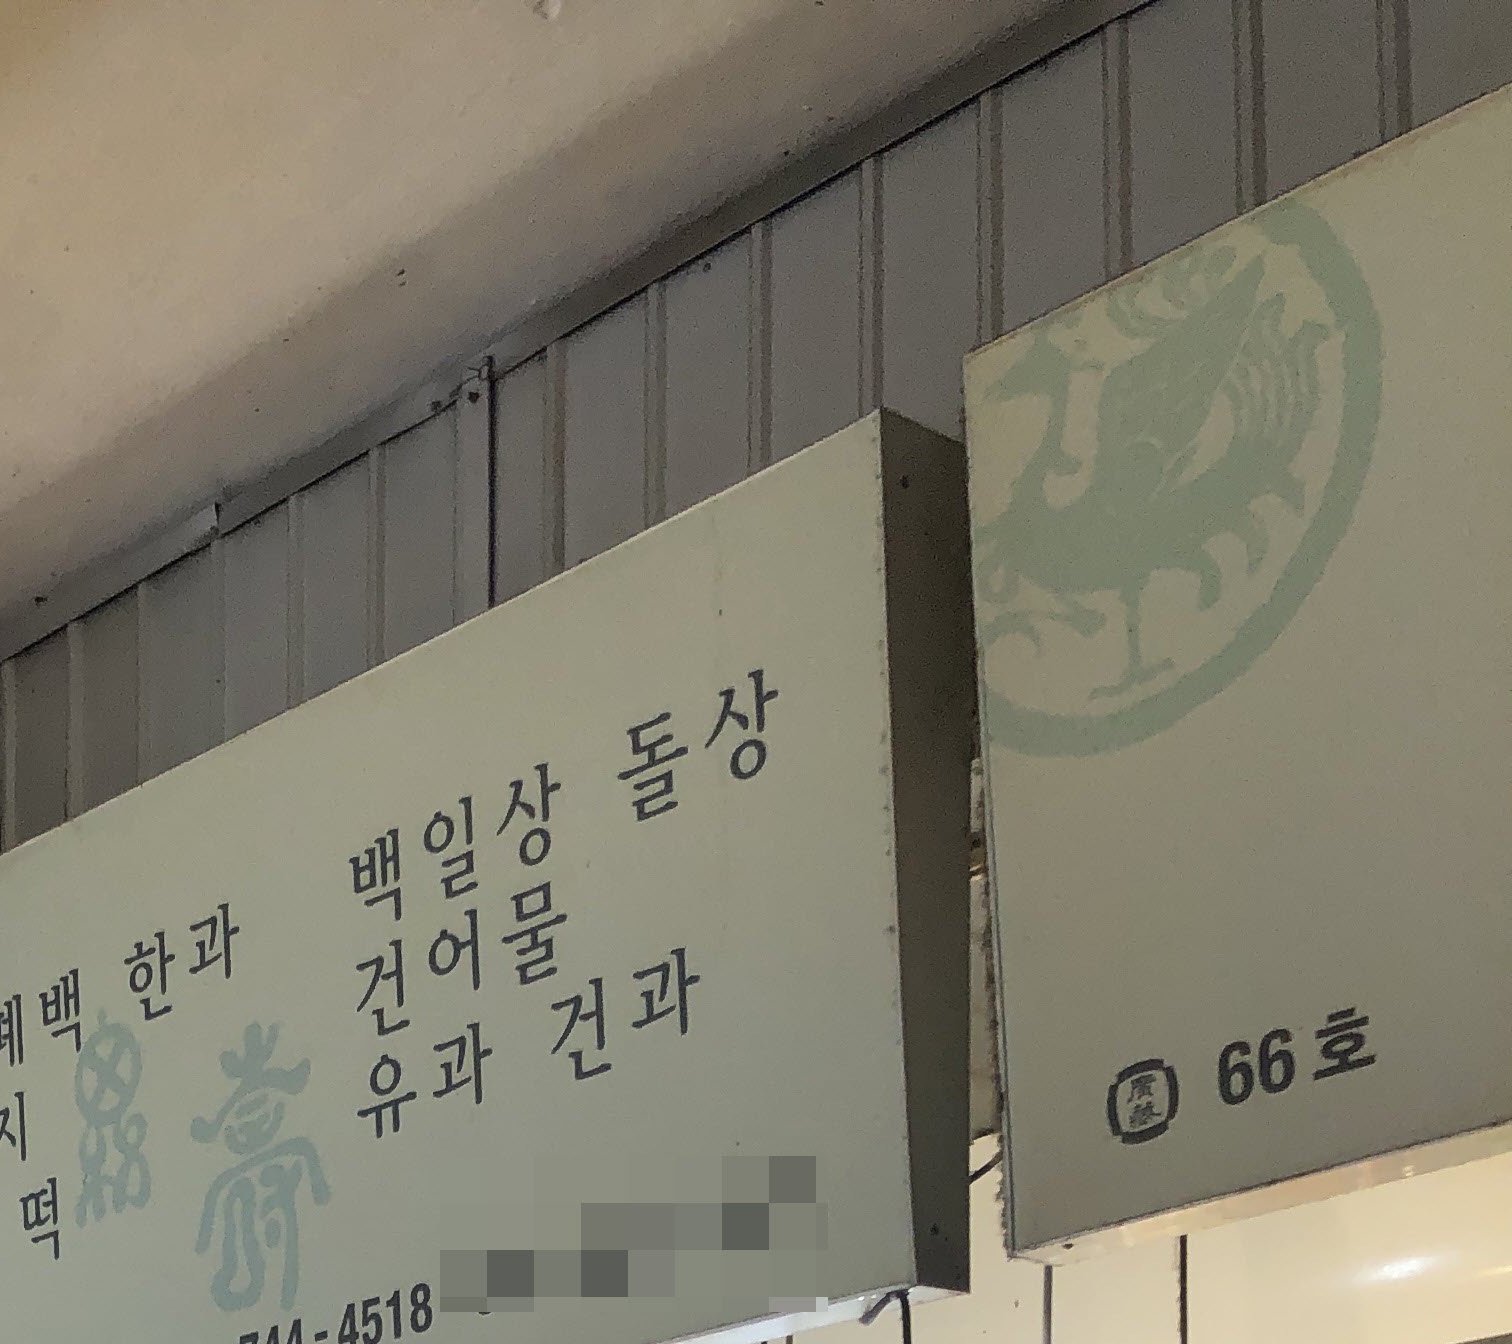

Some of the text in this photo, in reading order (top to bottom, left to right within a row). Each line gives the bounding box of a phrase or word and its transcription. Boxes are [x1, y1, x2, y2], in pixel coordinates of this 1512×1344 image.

[617, 669, 780, 821] 돌상
[124, 903, 240, 1022] 한과
[356, 882, 567, 1036] 건어물
[357, 947, 701, 1139] 유과 건과
[19, 1177, 60, 1261] 떡
